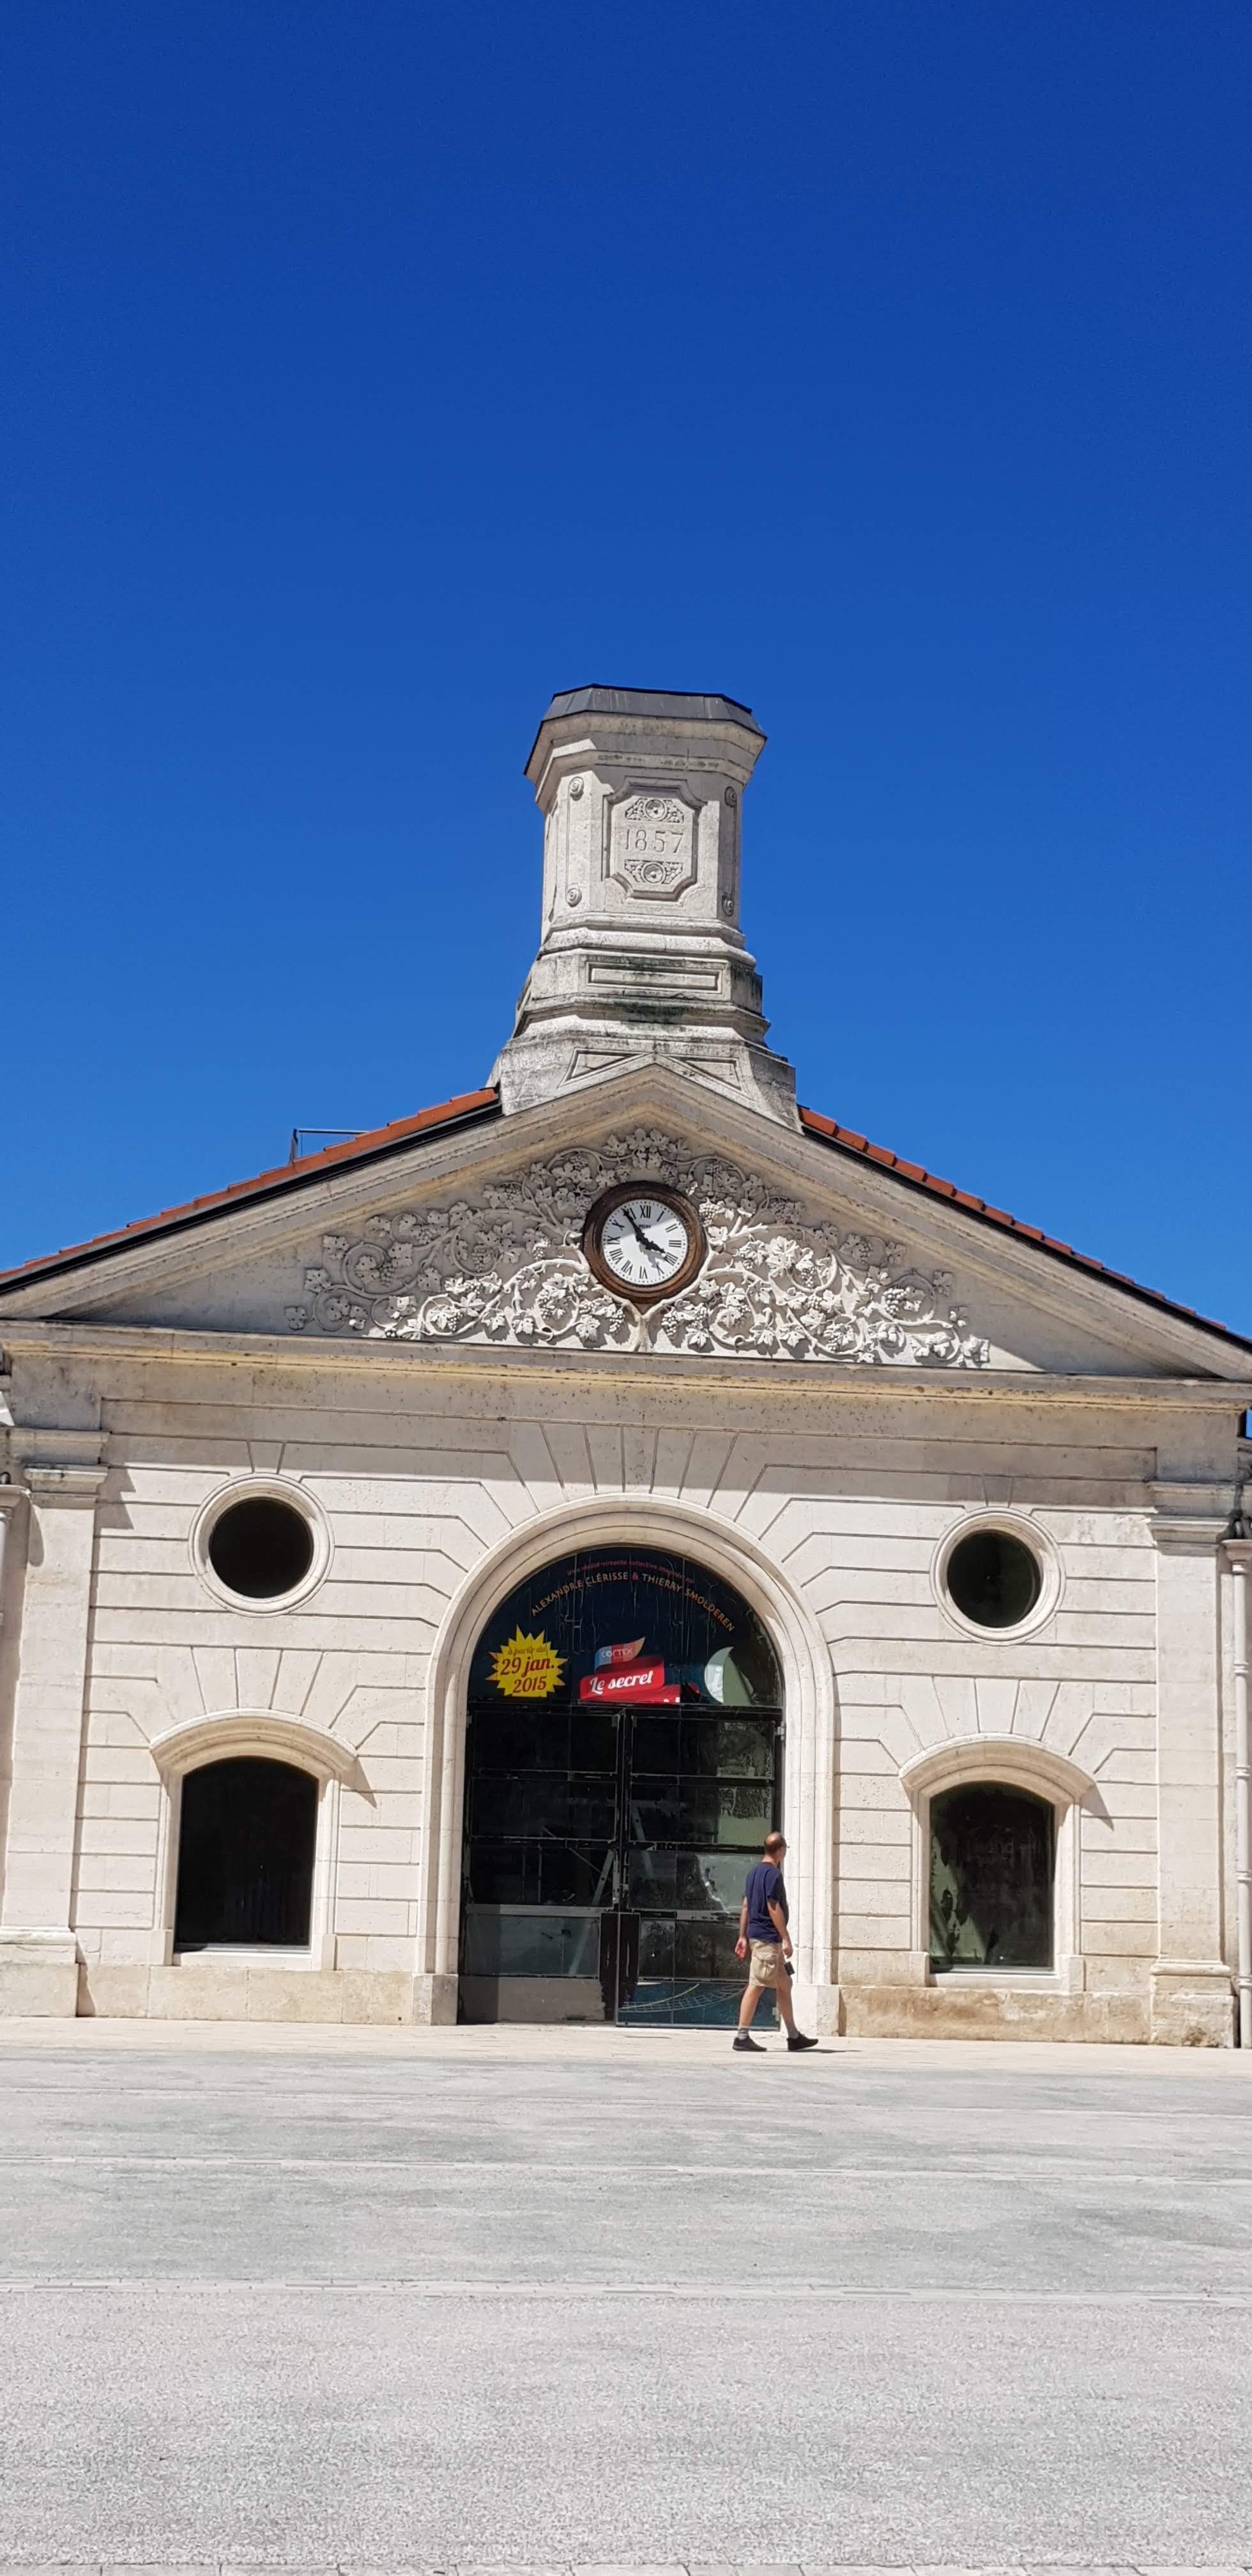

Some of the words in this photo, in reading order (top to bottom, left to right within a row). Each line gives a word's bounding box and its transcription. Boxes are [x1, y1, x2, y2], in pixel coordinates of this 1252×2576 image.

[623, 829, 683, 853] 1857
[639, 1205, 651, 1218] XII
[657, 1211, 664, 1222] I
[611, 1220, 625, 1231] X
[665, 1223, 678, 1233] II
[607, 1236, 620, 1245] IX
[609, 1248, 623, 1264] VIII
[621, 1260, 633, 1275] VII
[639, 1266, 648, 1279] VI
[656, 1264, 665, 1276] V
[531, 1579, 583, 1616] ALEXANDRE
[586, 1571, 629, 1584] CLÉRISSE
[632, 1572, 639, 1581] &
[642, 1572, 682, 1593] THIERRY
[684, 1588, 735, 1632] SMOLDEREN
[500, 1657, 521, 1675] 29
[521, 1656, 554, 1677] jan.
[513, 1676, 547, 1693] 2015
[590, 1676, 605, 1695] Le
[607, 1670, 653, 1689] secret
